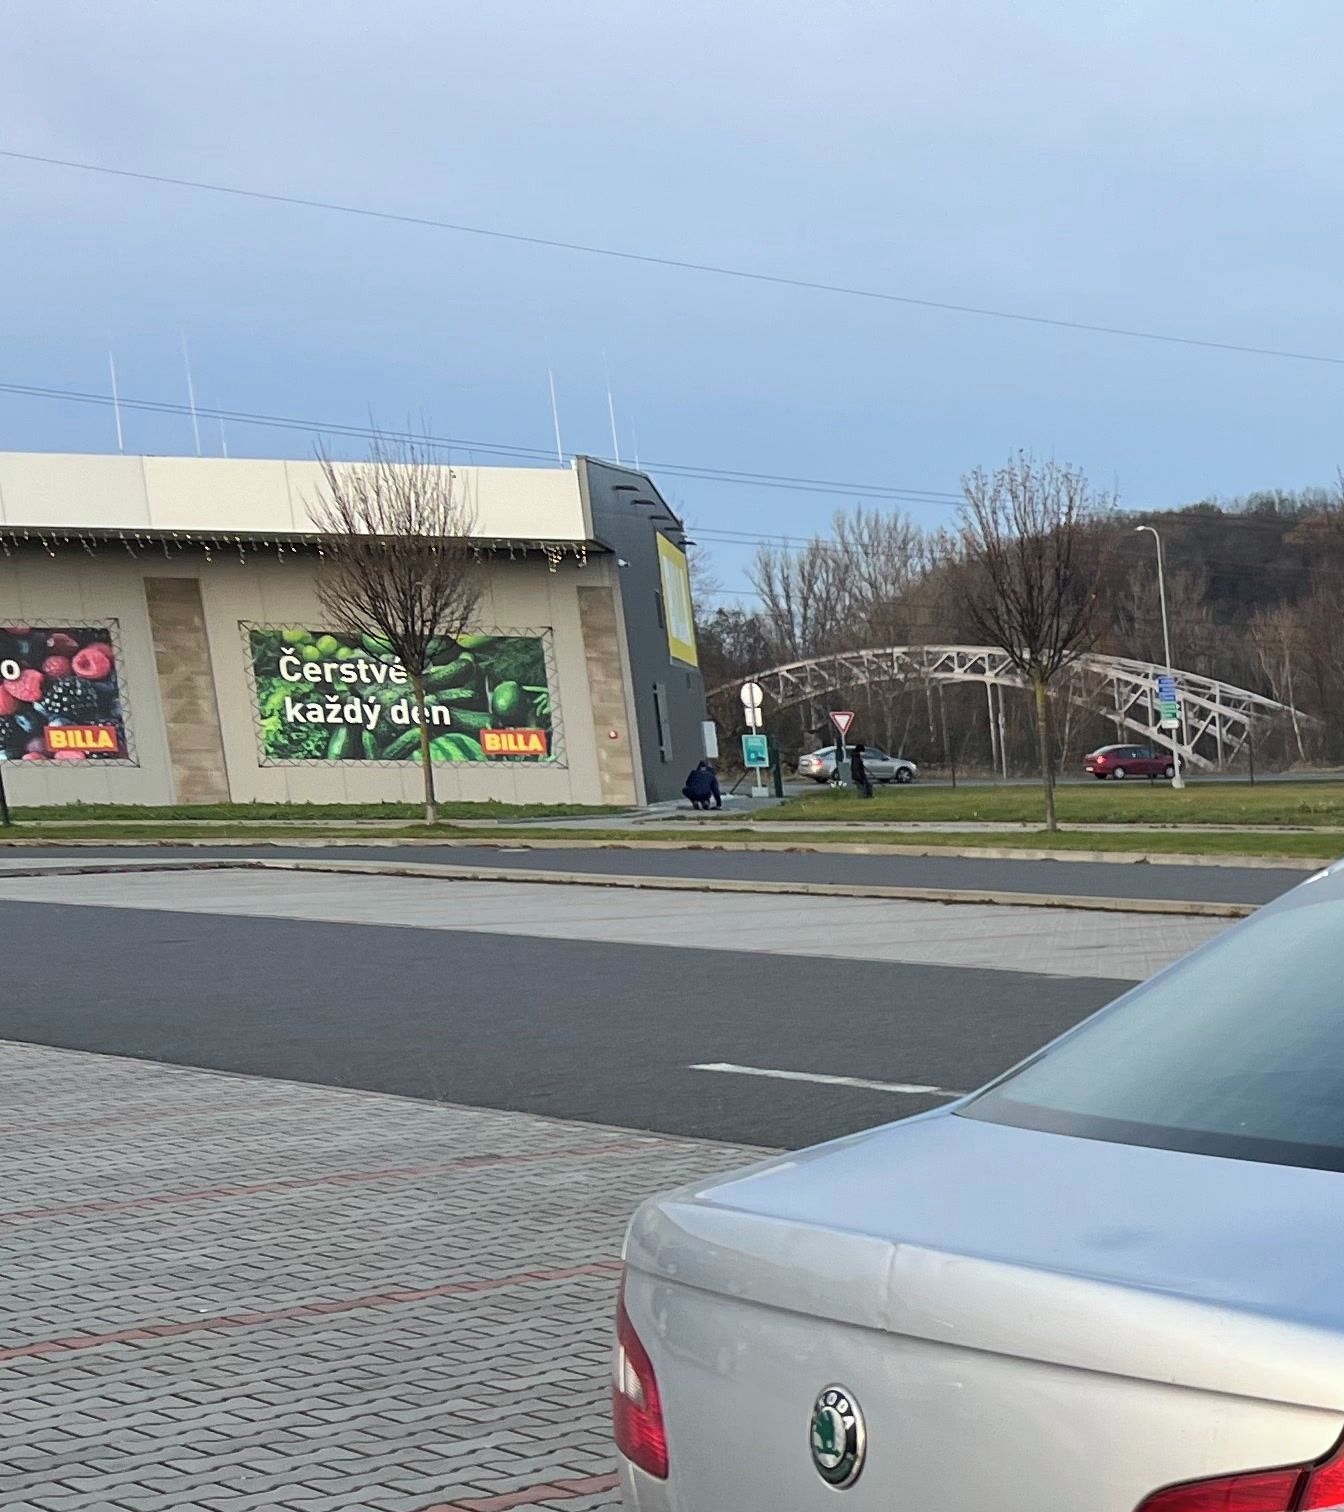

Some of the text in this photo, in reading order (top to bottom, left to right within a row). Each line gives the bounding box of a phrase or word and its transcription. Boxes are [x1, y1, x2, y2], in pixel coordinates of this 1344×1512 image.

[278, 646, 408, 684] Čerstvé
[283, 694, 451, 730] každý den
[49, 729, 114, 749] BILLA
[483, 733, 544, 752] BILLA
